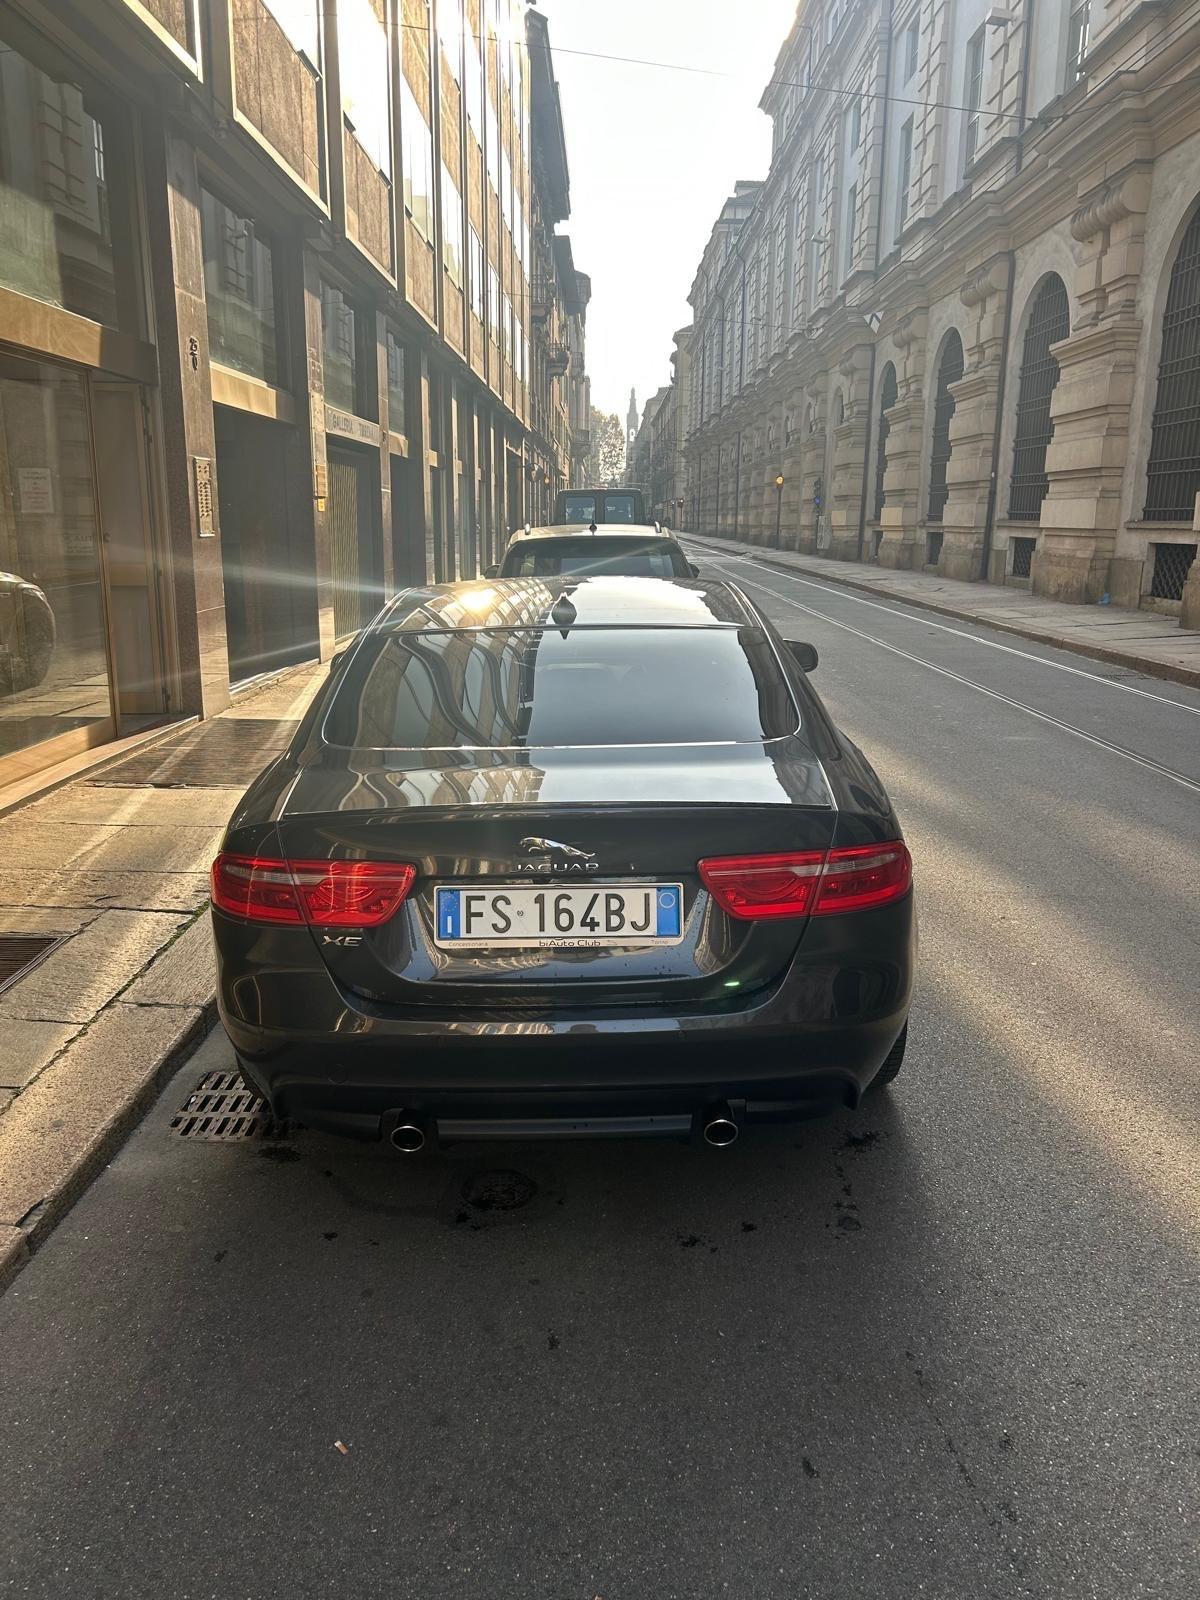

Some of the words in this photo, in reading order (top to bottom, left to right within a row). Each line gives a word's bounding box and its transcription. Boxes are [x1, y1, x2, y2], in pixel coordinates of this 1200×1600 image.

[510, 863, 599, 874] JAGUAR
[465, 894, 512, 934] FS
[534, 893, 651, 932] 164BJ
[322, 935, 362, 947] XE
[577, 939, 601, 947] Club
